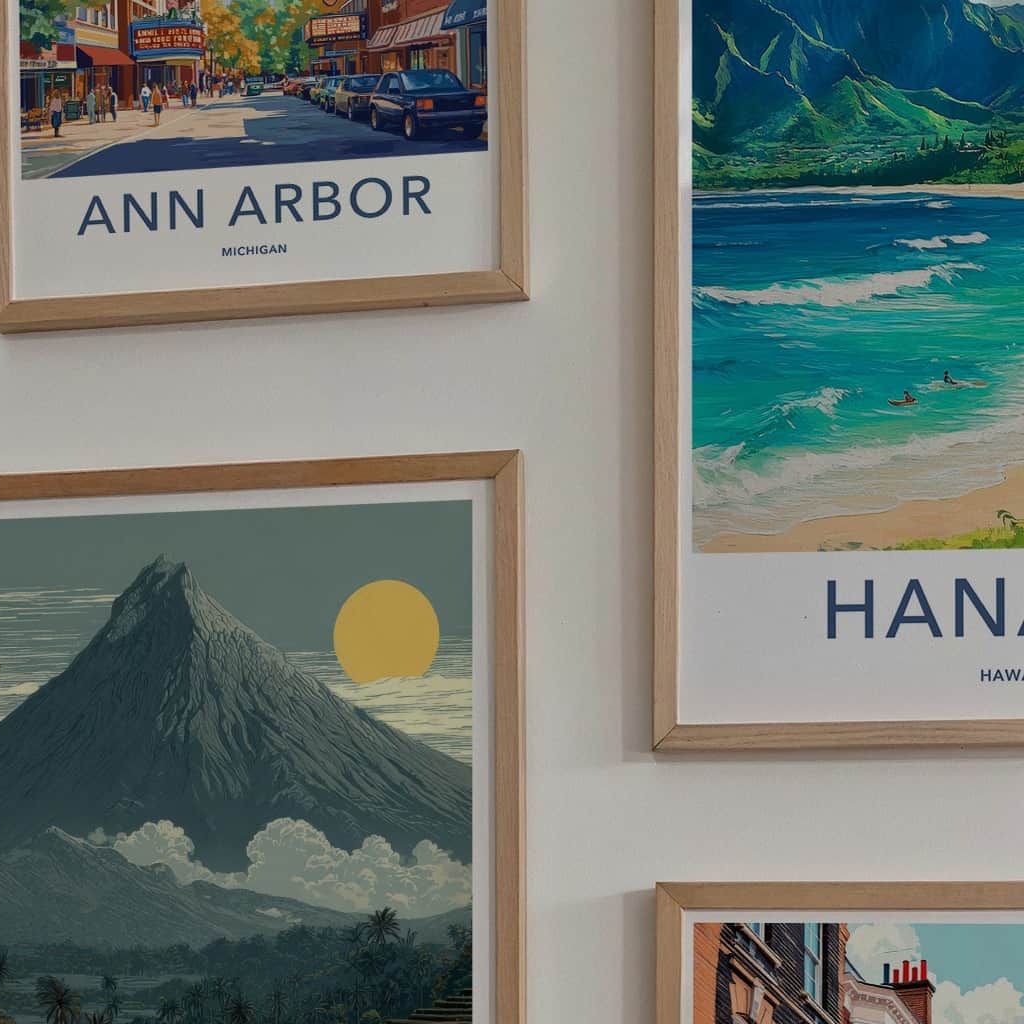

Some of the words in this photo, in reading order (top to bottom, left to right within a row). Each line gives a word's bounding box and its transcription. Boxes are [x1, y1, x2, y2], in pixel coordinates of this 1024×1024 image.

[78, 189, 204, 236] ANN
[229, 175, 432, 227] ARBOR
[222, 245, 287, 257] MICHIGAN
[827, 578, 1024, 640] HAN
[980, 669, 1024, 682] HAW
